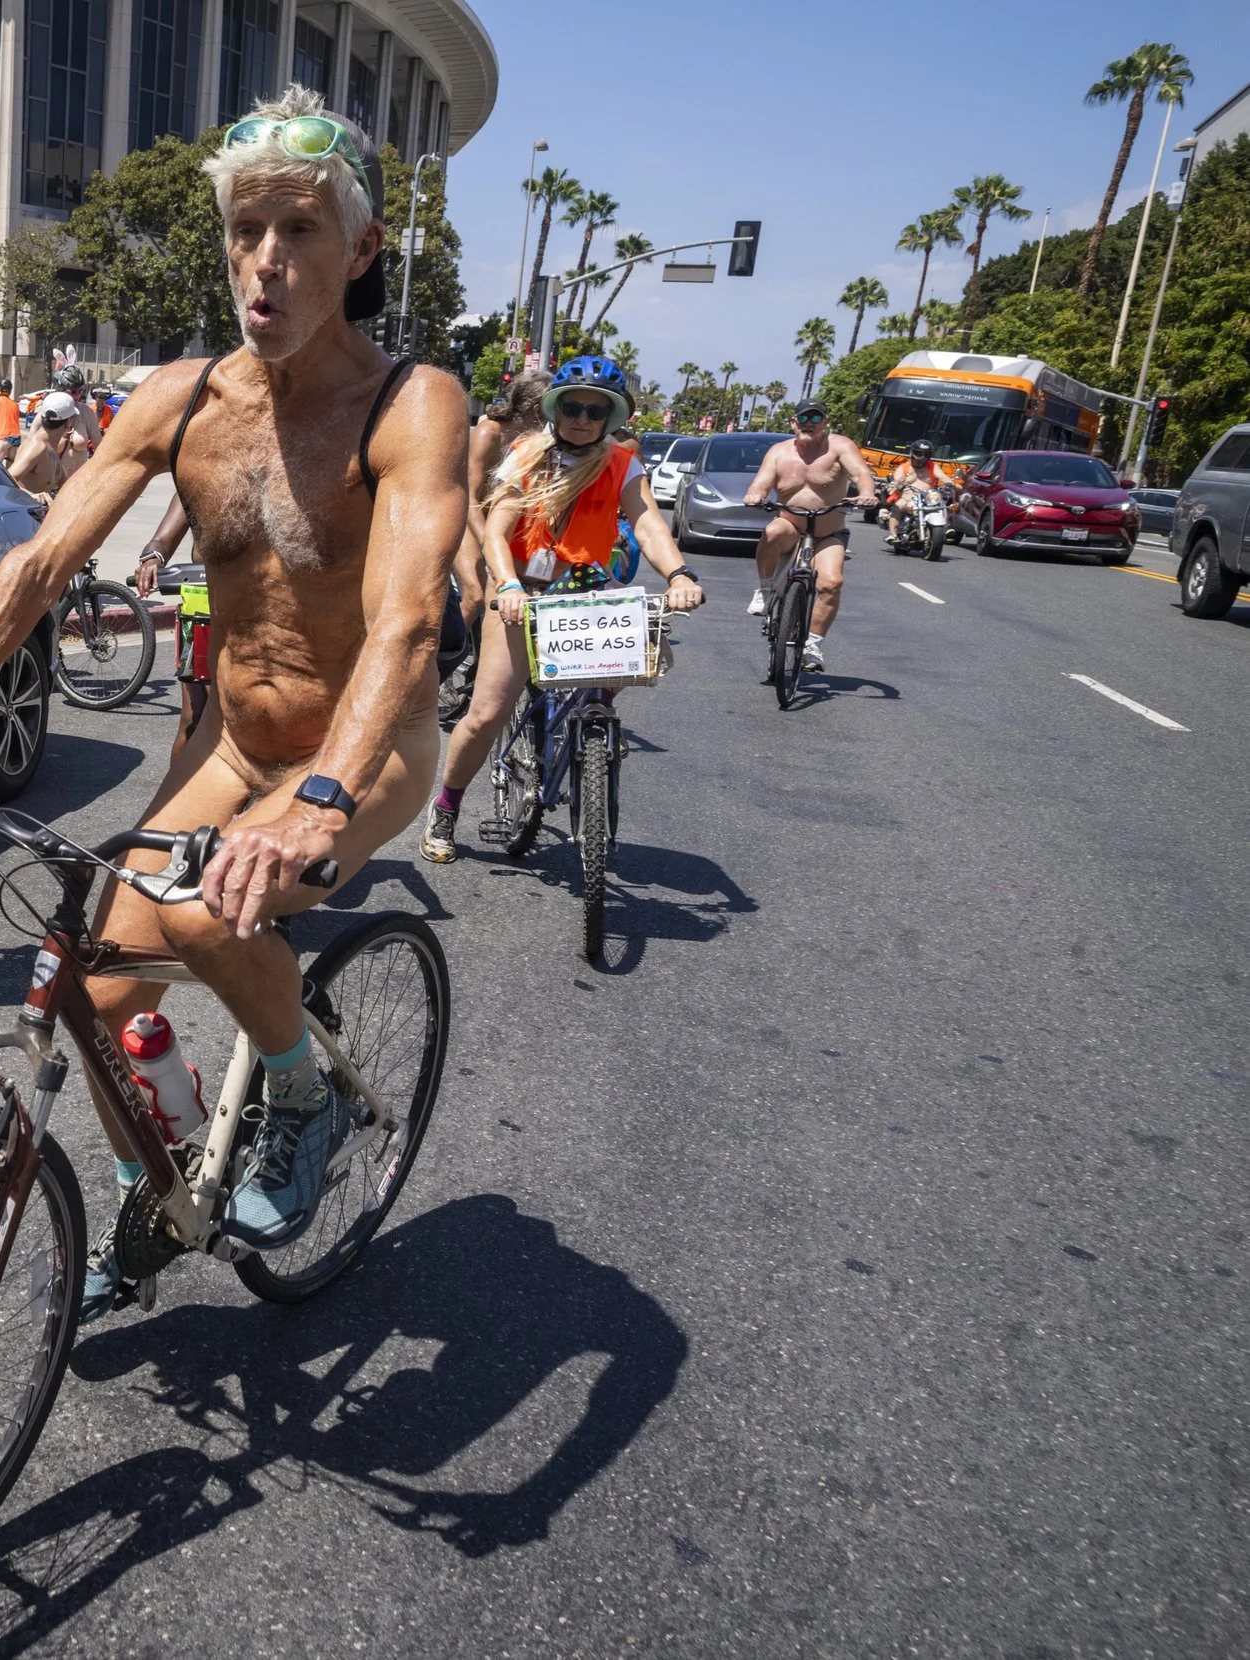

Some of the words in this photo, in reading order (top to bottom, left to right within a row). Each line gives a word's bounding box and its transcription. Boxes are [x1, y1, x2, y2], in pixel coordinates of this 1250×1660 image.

[549, 618, 590, 632] LESS
[597, 615, 631, 629] GAS
[547, 638, 593, 653] MORE
[602, 636, 635, 650] ASS
[597, 662, 624, 671] Angeles
[94, 1037, 147, 1120] TREK
